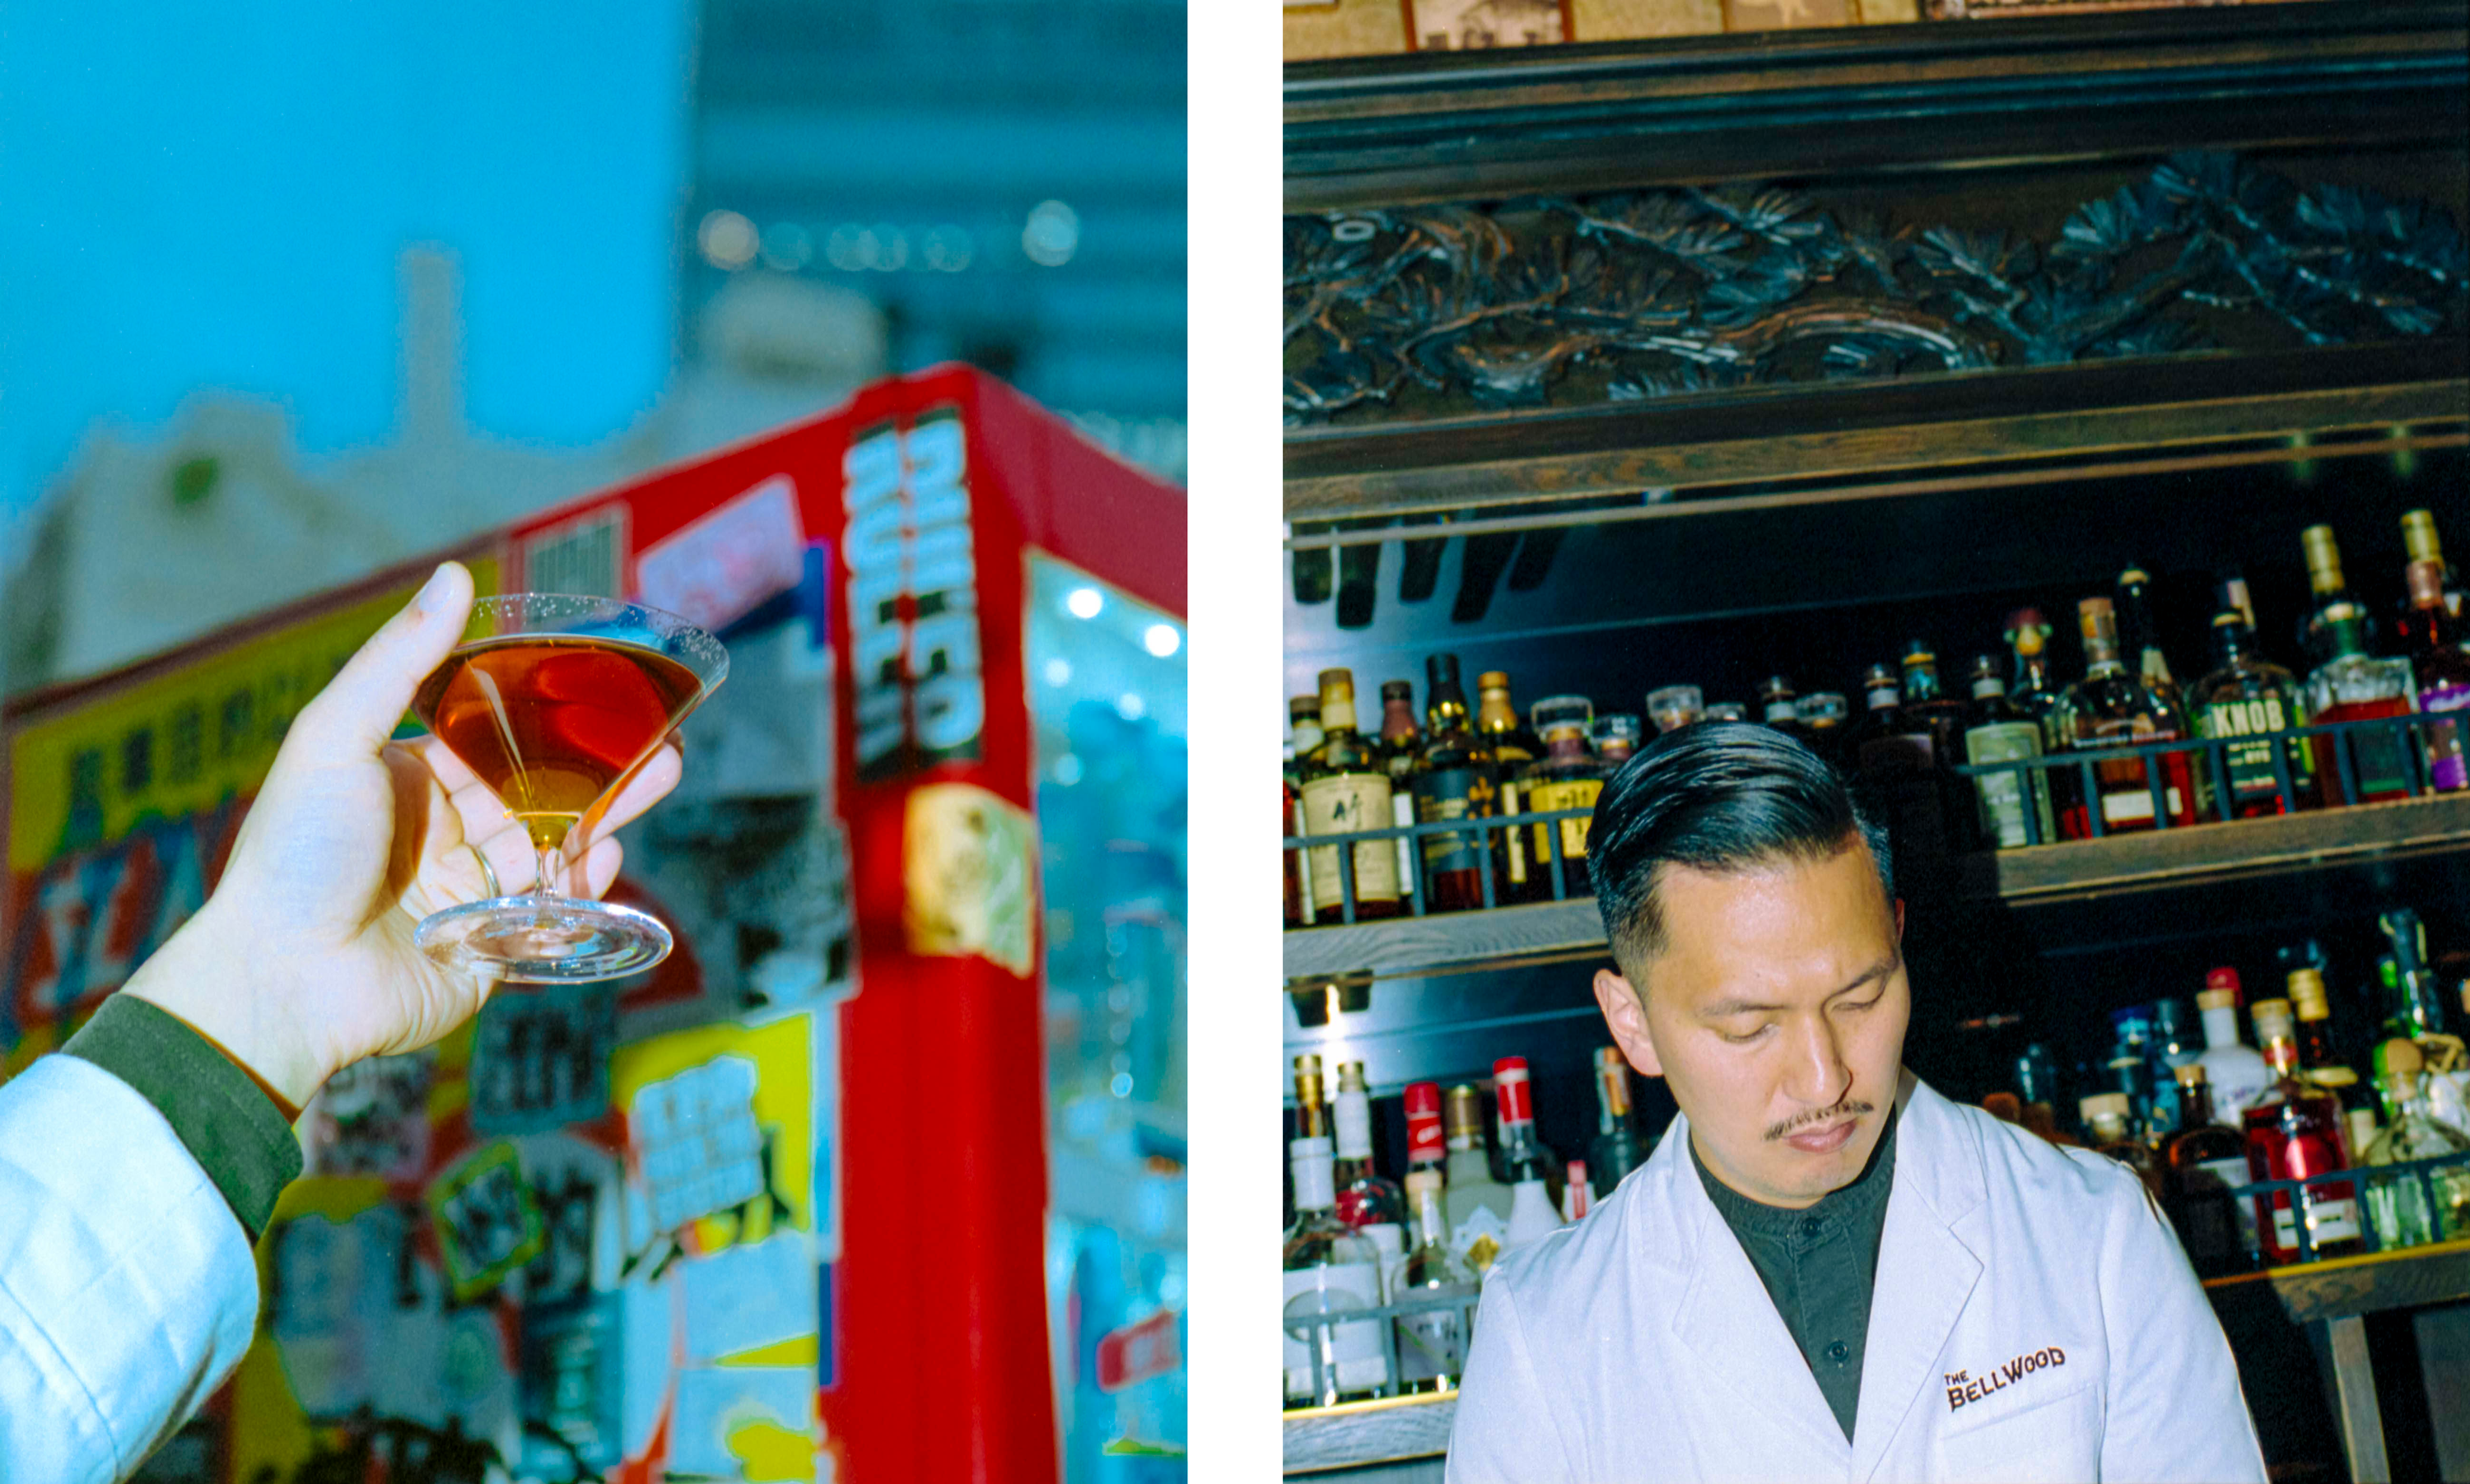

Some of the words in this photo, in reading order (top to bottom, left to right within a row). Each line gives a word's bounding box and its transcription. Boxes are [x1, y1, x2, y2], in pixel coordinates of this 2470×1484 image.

[2211, 699, 2286, 737] KNOB
[1944, 1369, 1969, 1386] THE
[1946, 1346, 2066, 1413] BELLWOOD
